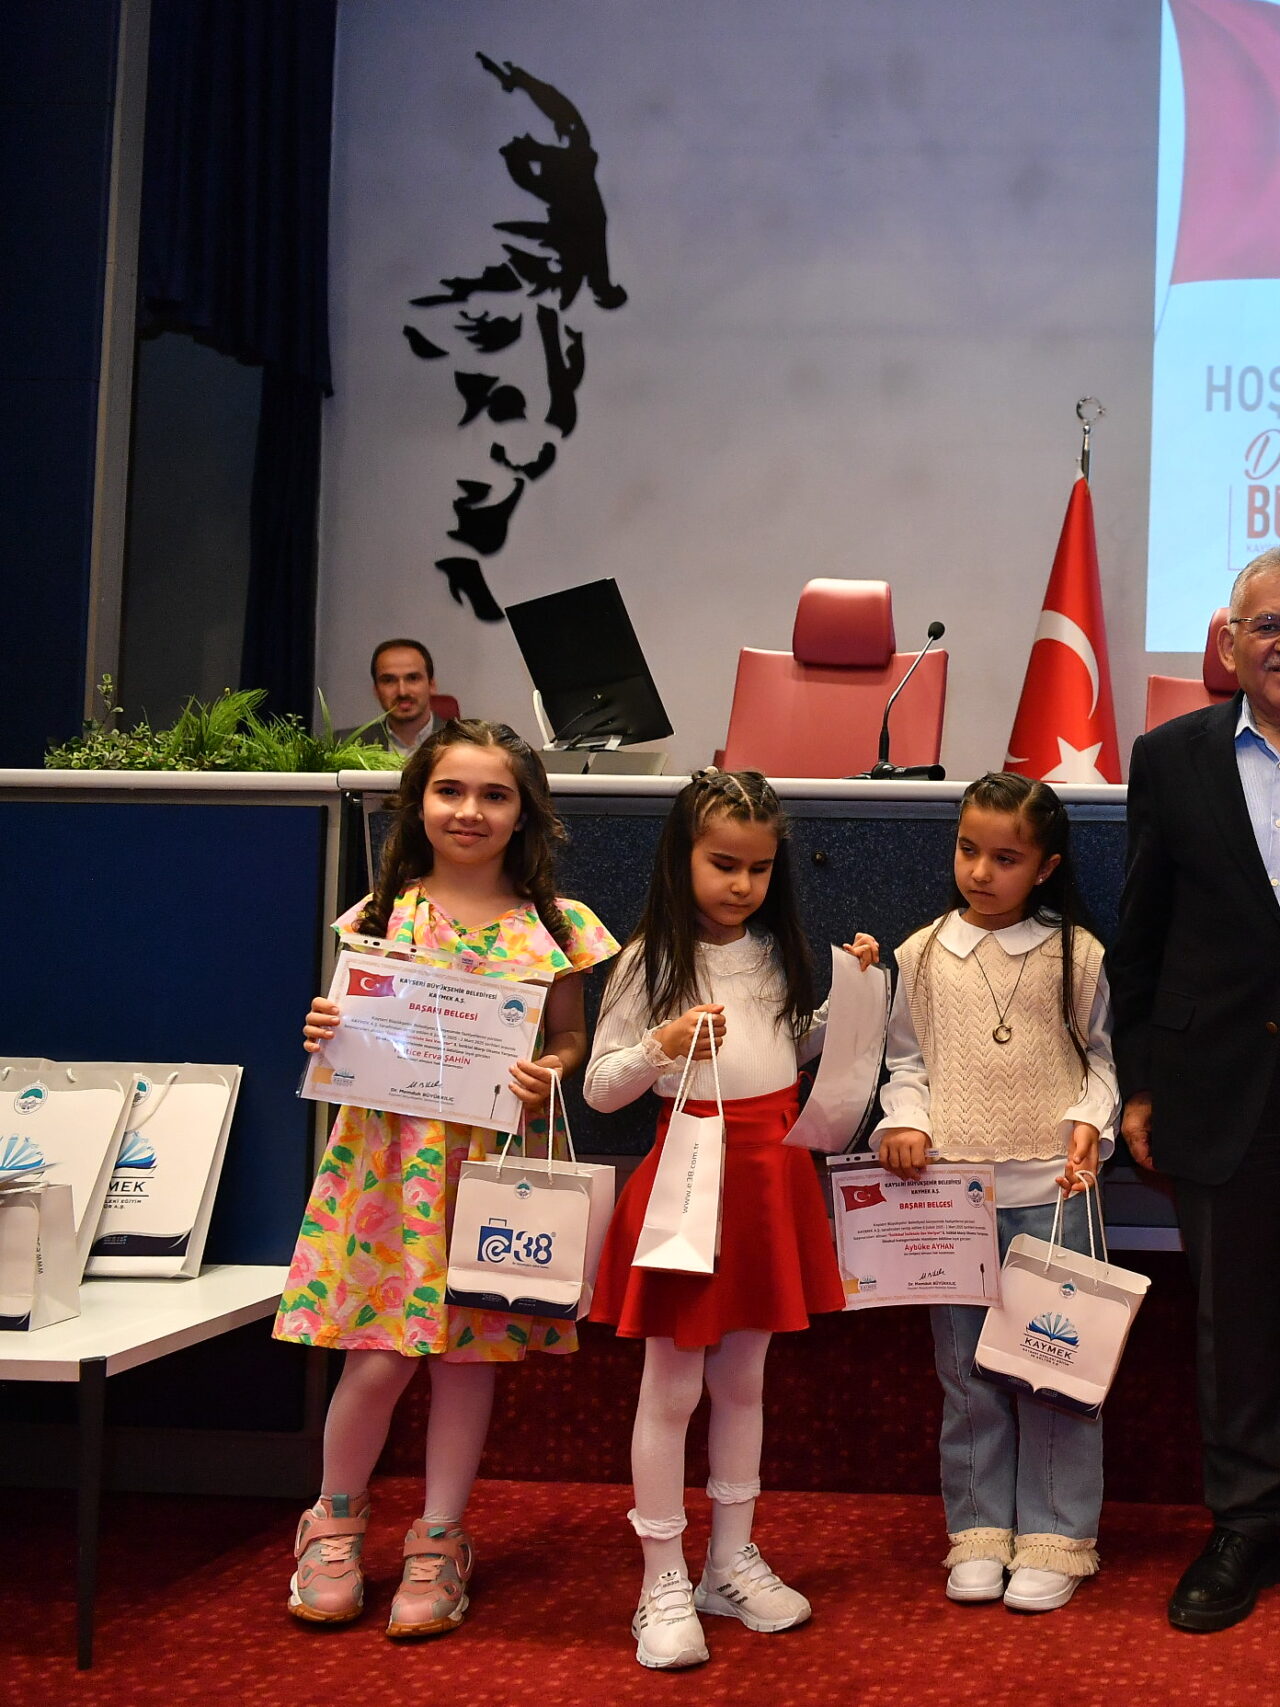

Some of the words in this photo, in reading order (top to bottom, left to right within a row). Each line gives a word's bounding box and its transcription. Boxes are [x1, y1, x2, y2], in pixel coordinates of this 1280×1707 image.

[400, 978, 425, 987] KAYSERİ
[466, 990, 498, 1000] BELEDİYESİ
[443, 1009, 478, 1021] BELGESİ
[423, 1051, 442, 1060] Erva
[444, 1054, 471, 1065] ŞAHİN
[899, 1201, 926, 1210] BAŞARI
[927, 1199, 953, 1209] BELGESİ
[904, 1243, 930, 1252] Aybüke
[1024, 1337, 1073, 1360] KAYMEK
